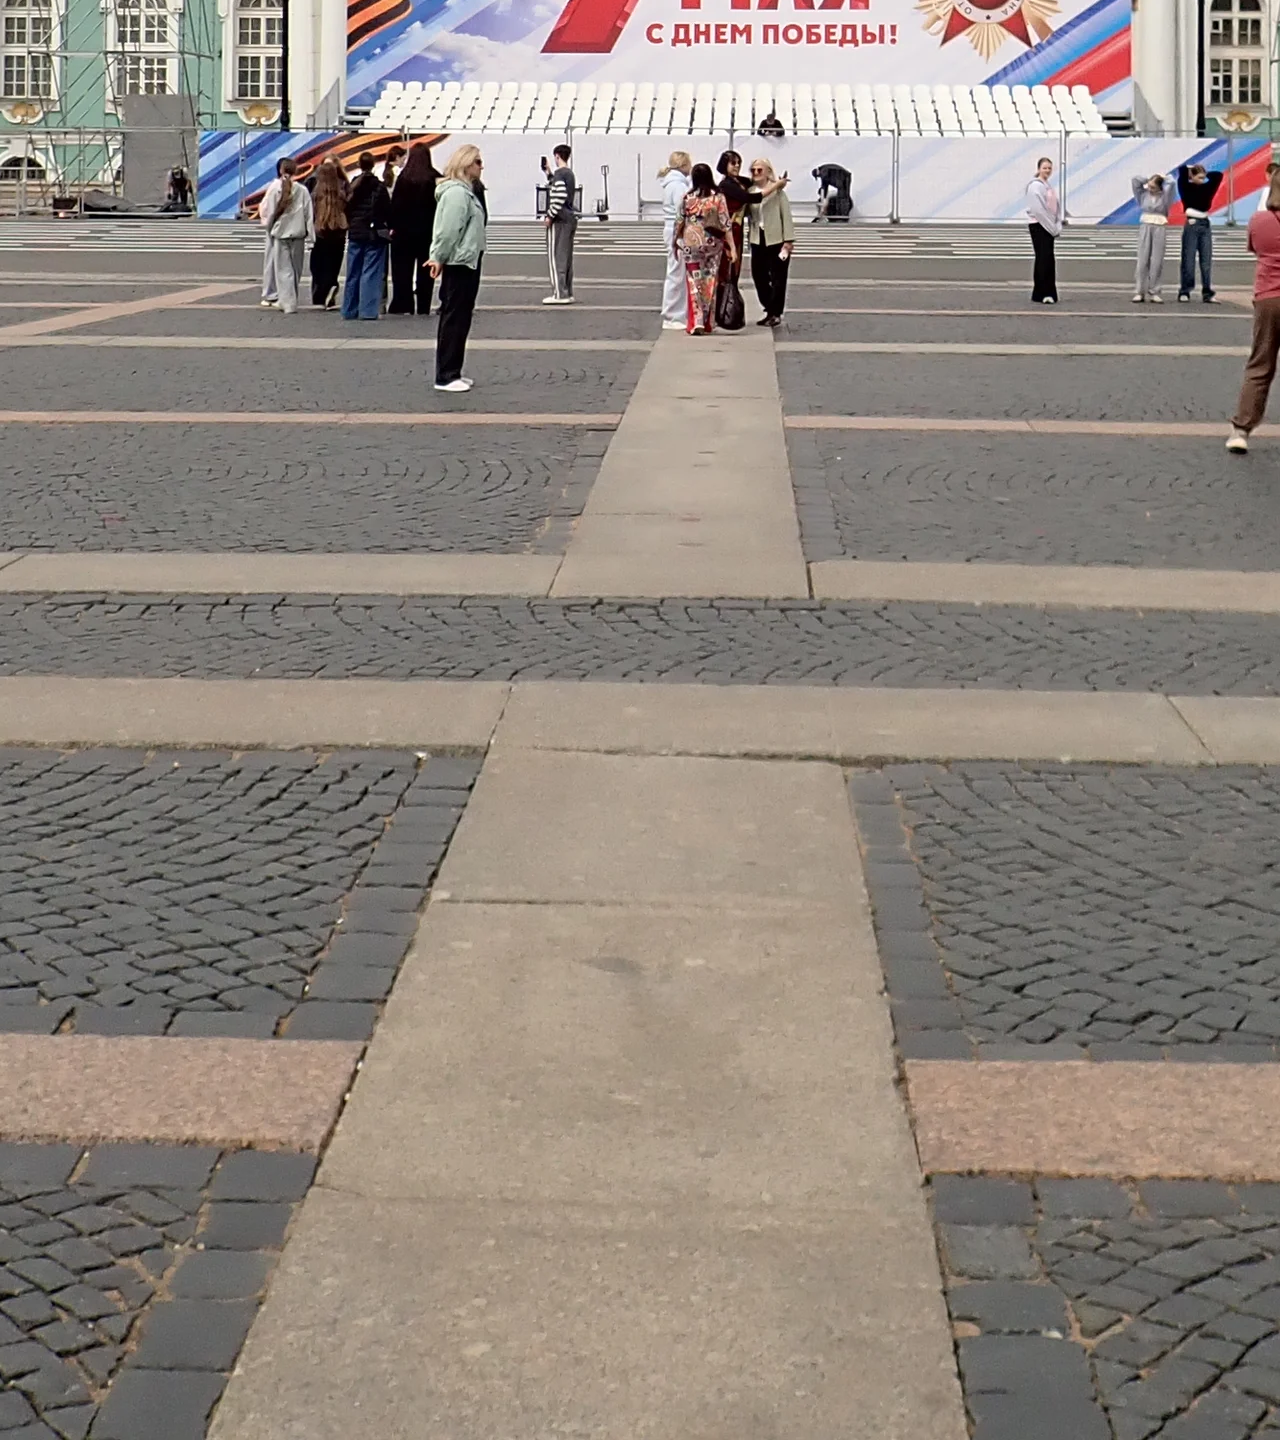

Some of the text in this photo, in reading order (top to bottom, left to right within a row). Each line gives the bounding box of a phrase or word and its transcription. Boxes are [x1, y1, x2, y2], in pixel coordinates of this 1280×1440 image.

[645, 23, 898, 47] С ДНЕМ ПОБЕДЫ!
